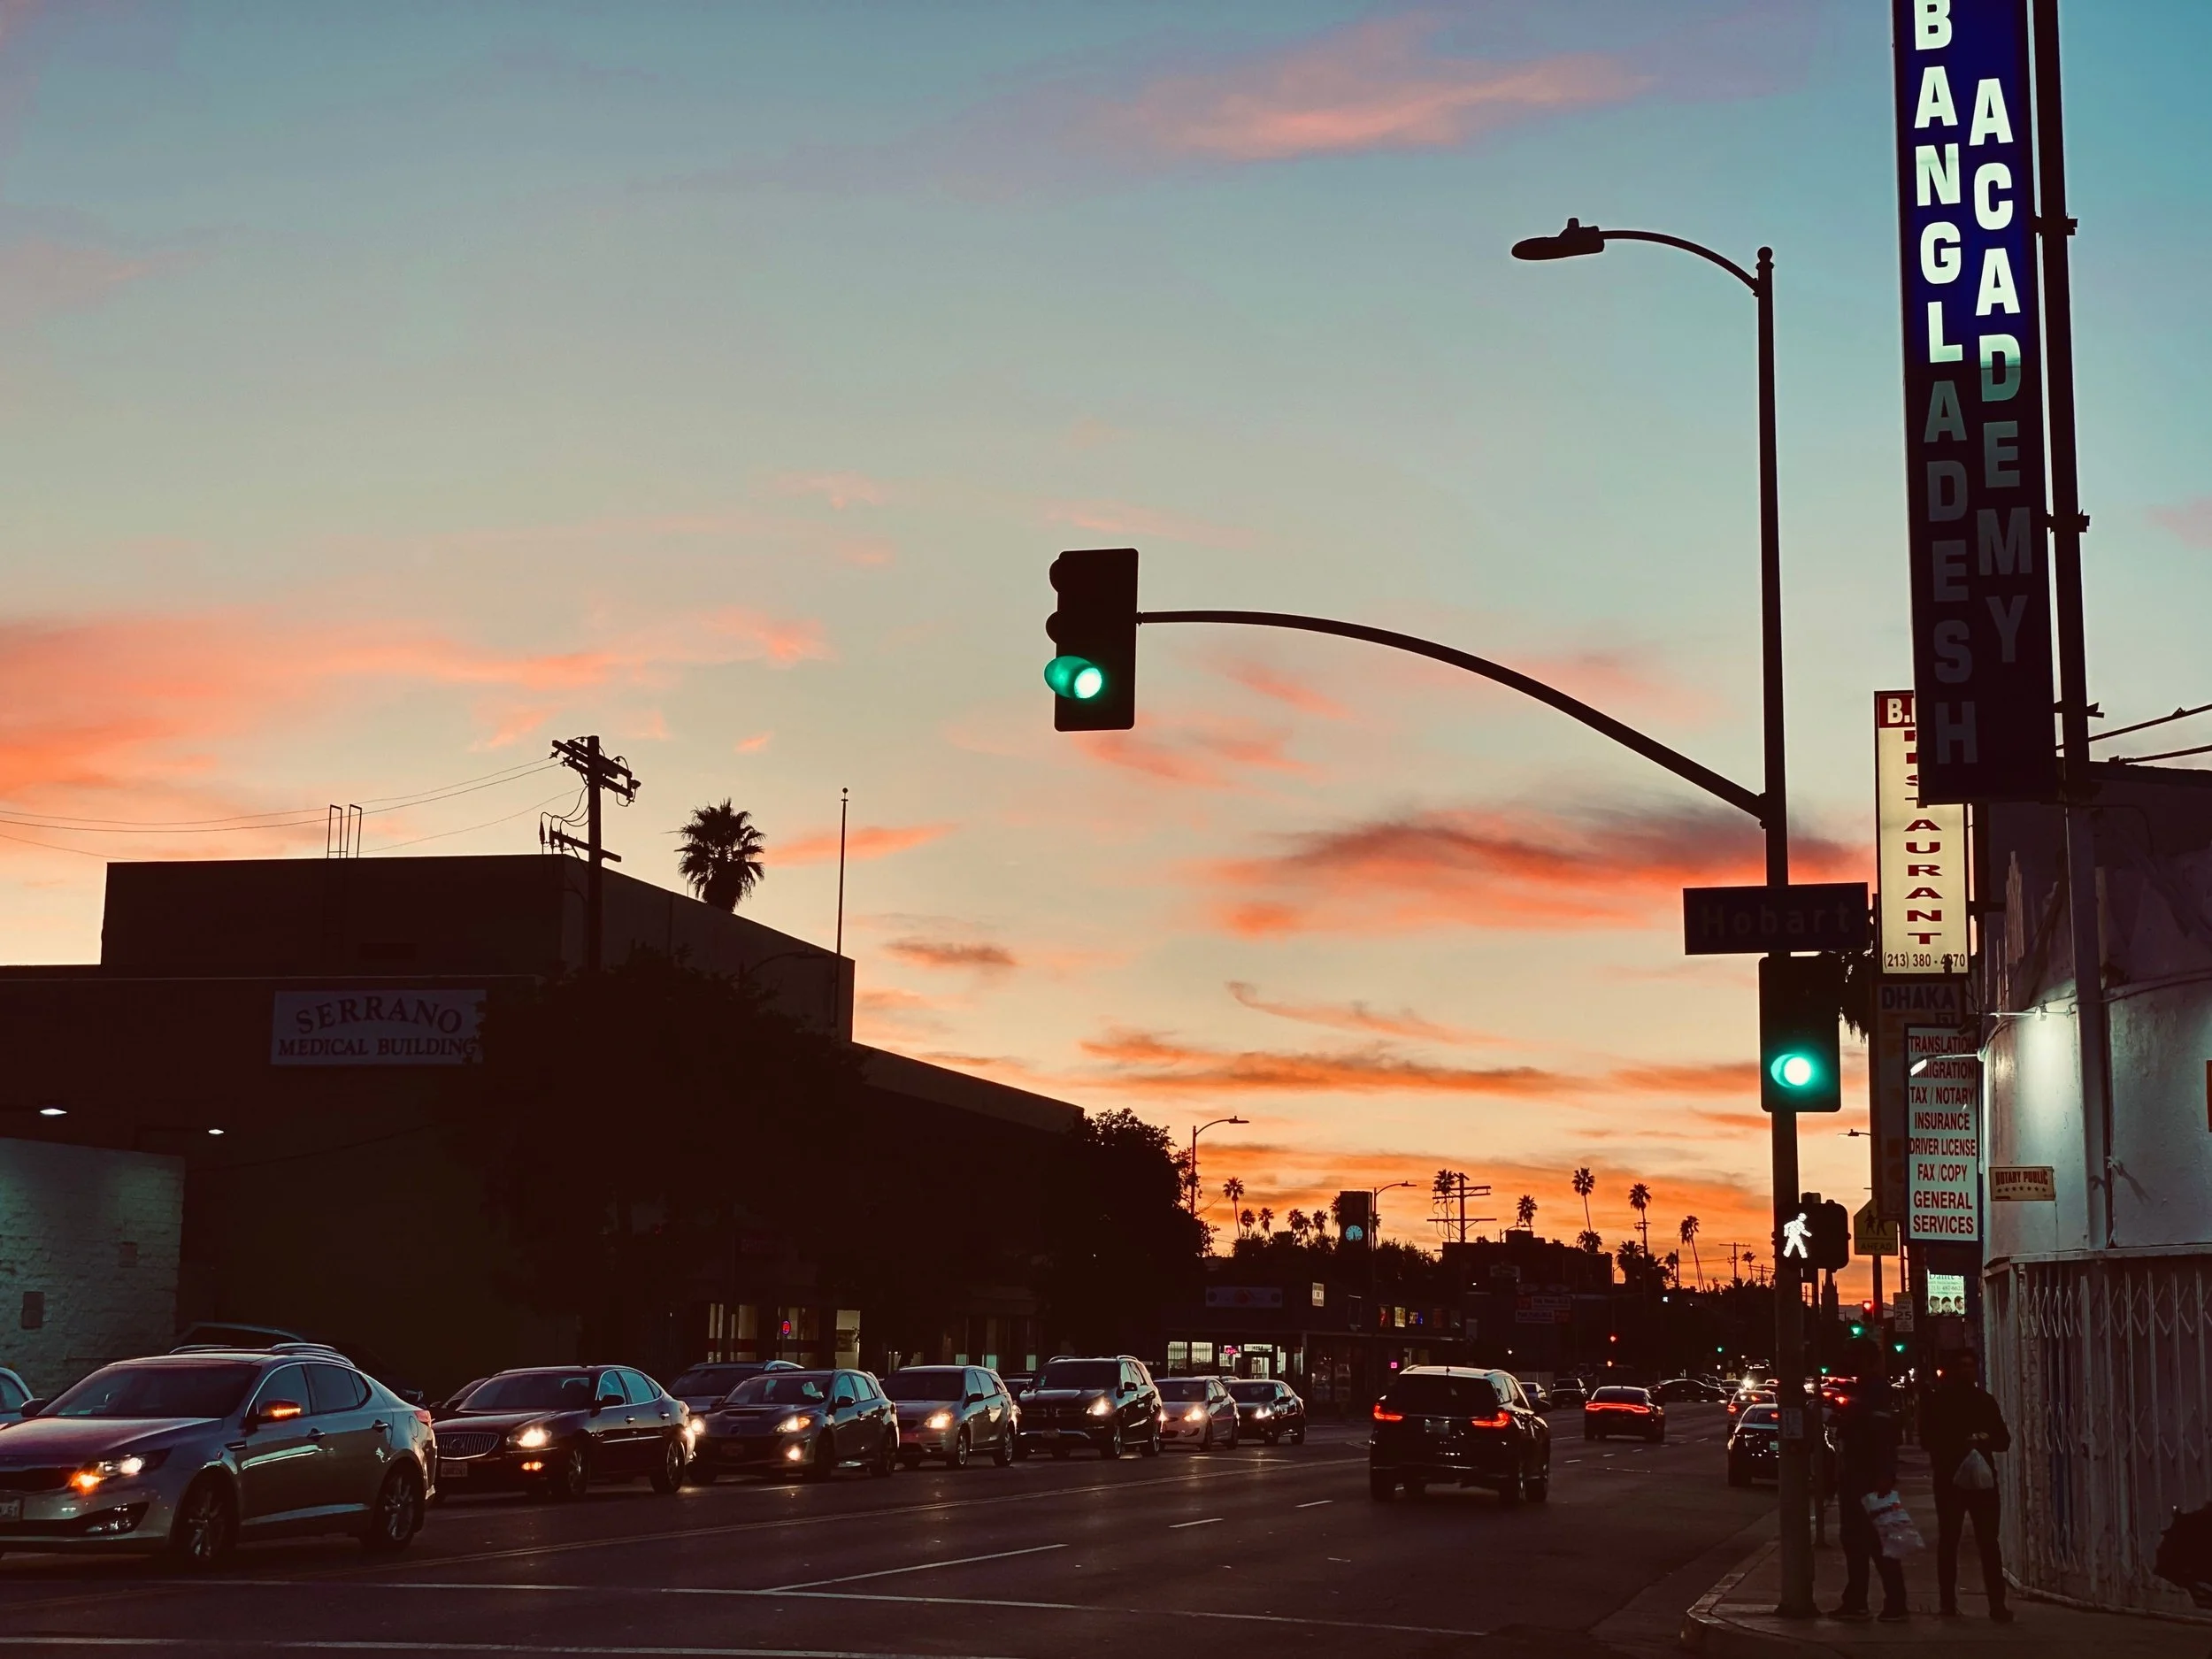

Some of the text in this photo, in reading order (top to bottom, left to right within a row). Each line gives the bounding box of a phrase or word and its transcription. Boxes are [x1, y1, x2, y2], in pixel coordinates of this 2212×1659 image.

[1969, 78, 2032, 663] ACADEMY
[1913, 0, 1978, 765] BANGLADESH
[1701, 900, 1851, 936] Hobart
[1884, 951, 1909, 970] (213)
[1912, 953, 1932, 967] 380
[1882, 986, 1955, 1009] DHAKA
[296, 996, 463, 1034] SERRANO
[278, 1038, 476, 1056] MEDICAL BUILDING
[1911, 1061, 1974, 1079] MIGRATION
[1910, 1087, 1927, 1104] TAX
[1936, 1087, 1975, 1105] NOTARY
[1915, 1111, 1970, 1131] INSURANCE
[1910, 1138, 1976, 1156] DRIVER LICENSE
[1917, 1163, 1935, 1181] FAX
[1994, 1170, 2048, 1186] NOTARY PUBLIC
[1914, 1190, 1973, 1210] GENERAL
[1913, 1215, 1974, 1234] SERVICES
[1860, 1242, 1893, 1251] AHEAD
[1896, 1311, 1912, 1320] 25
